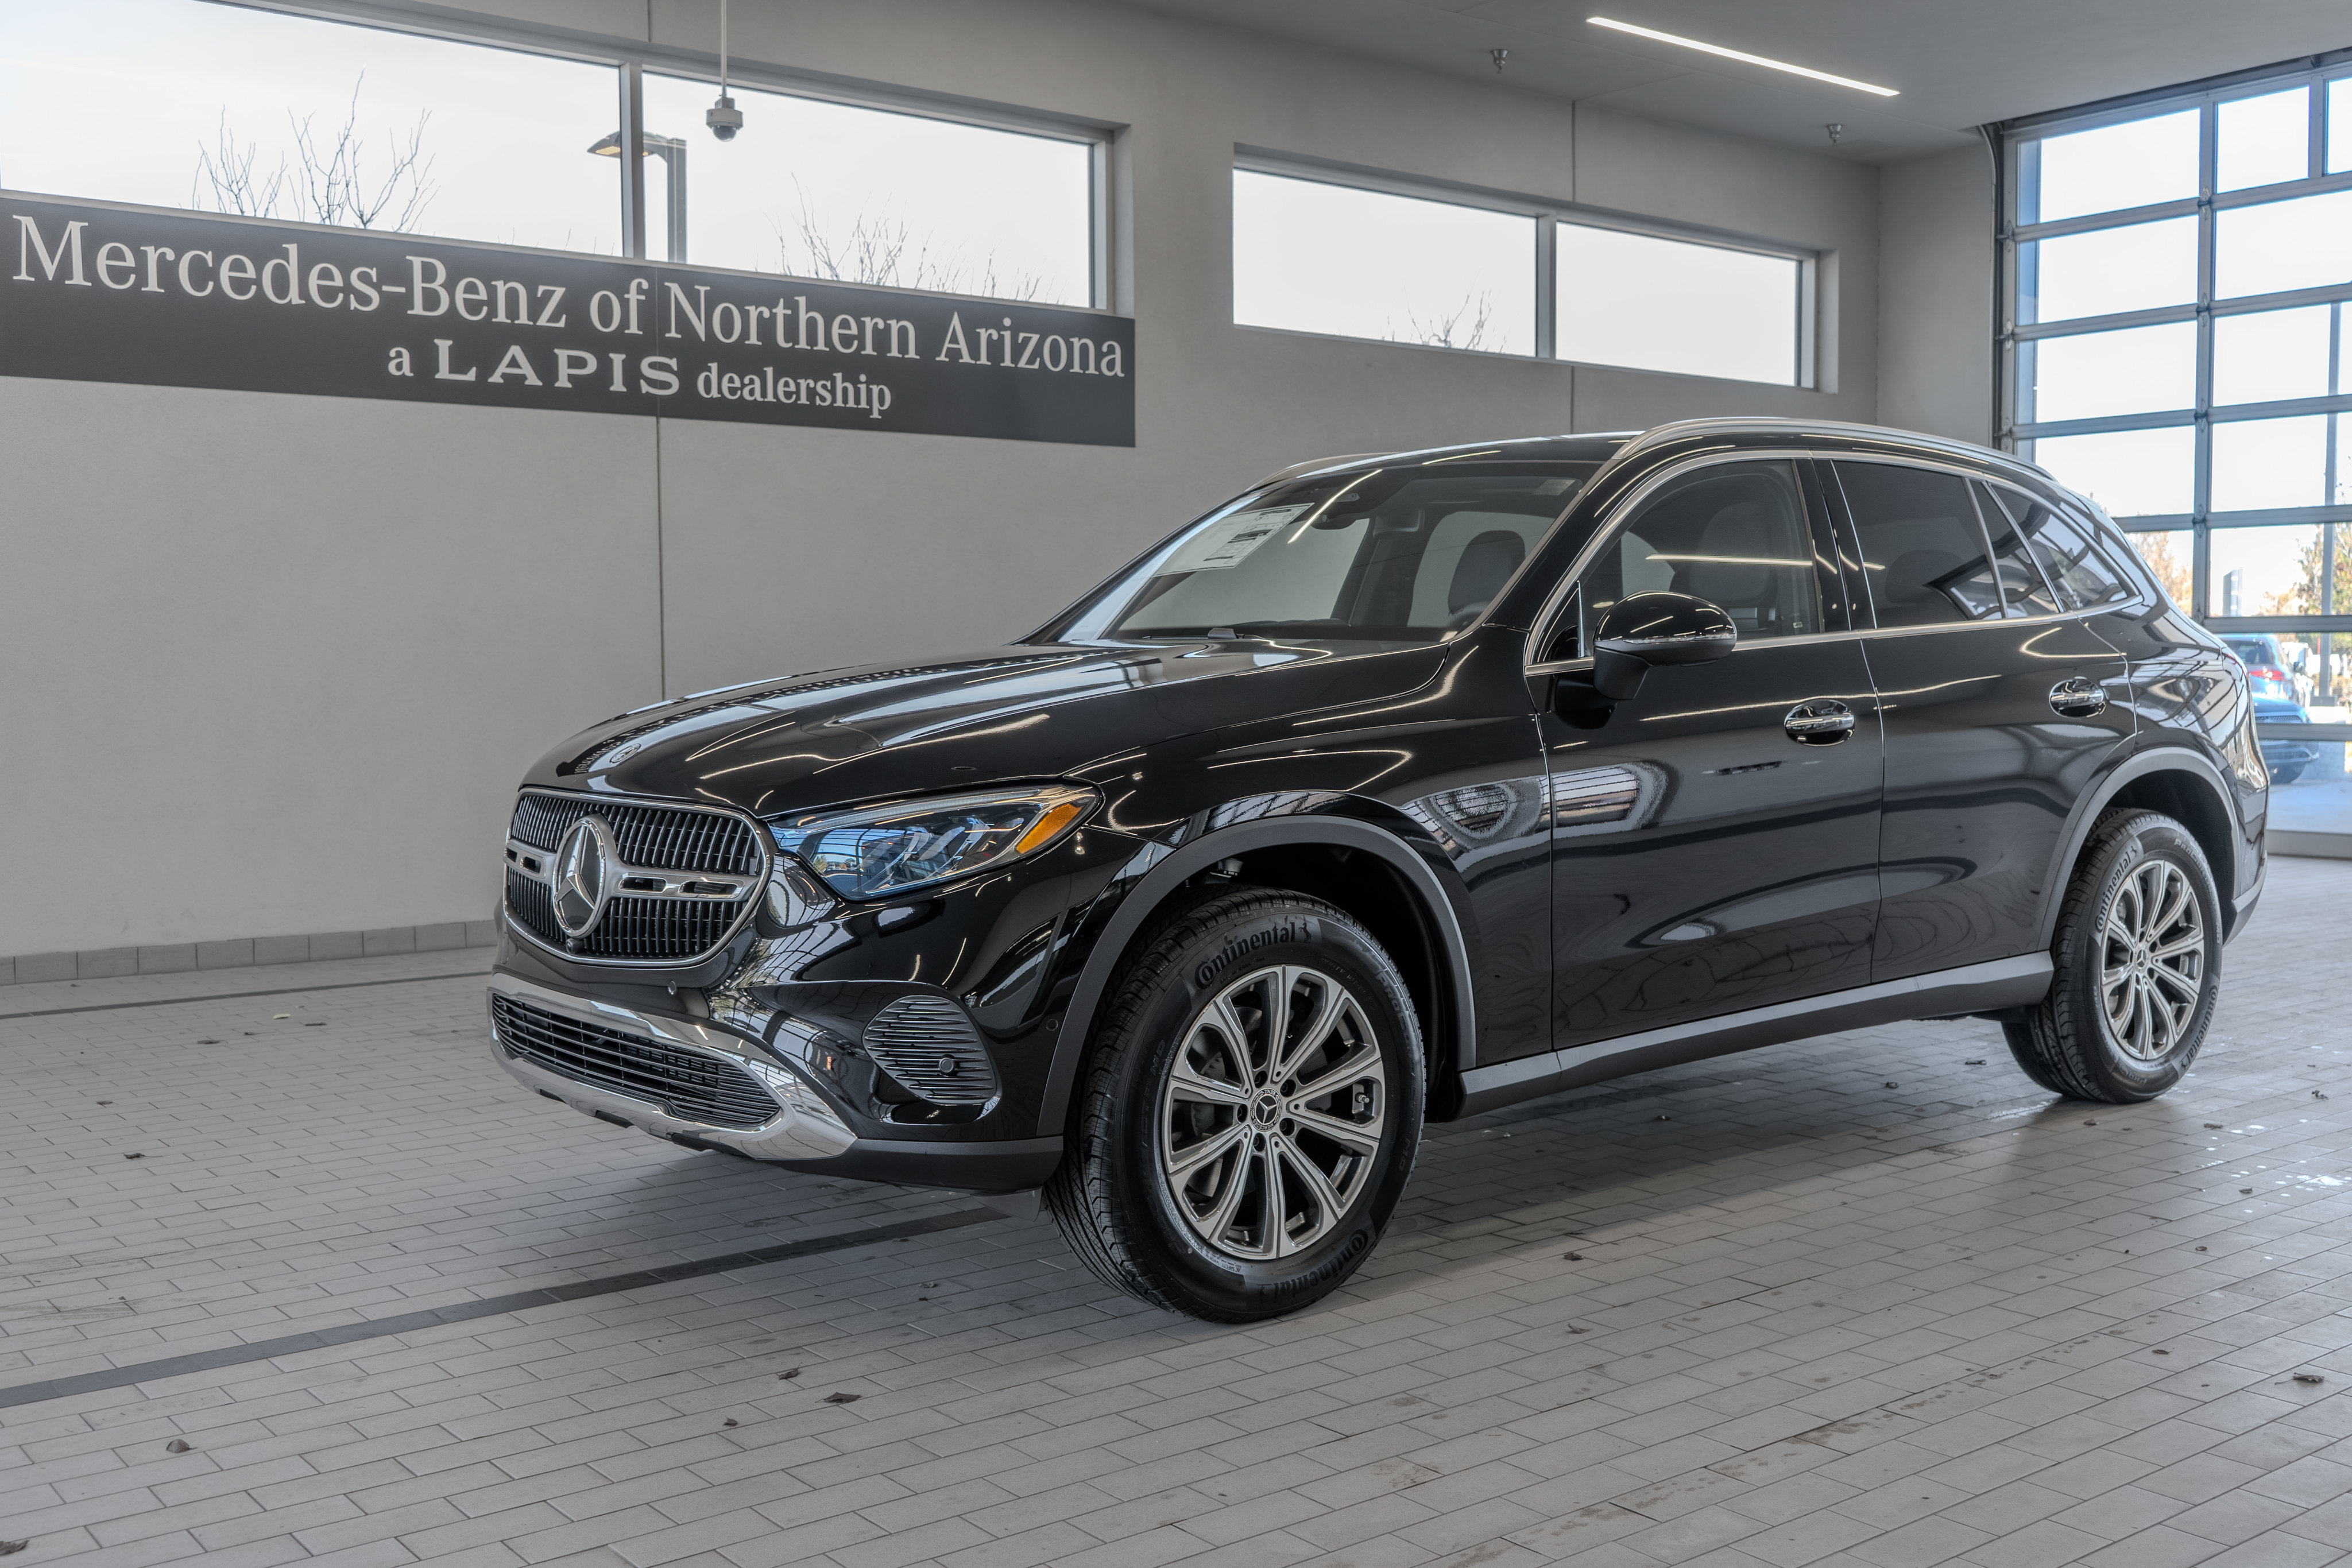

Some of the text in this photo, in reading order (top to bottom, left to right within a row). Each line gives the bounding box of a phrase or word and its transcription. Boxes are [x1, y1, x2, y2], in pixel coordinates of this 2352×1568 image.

[13, 215, 1125, 377] Mercedes-Benz of Northern Arizona
[388, 339, 892, 419] a LAPIS dealership
[2095, 850, 2132, 934] Continental
[1194, 922, 1295, 989] Continental
[2184, 981, 2218, 1063] Continental
[1252, 1118, 1274, 1130] MERCEDES
[1222, 1263, 1235, 1272] SAFETY
[1274, 1229, 1368, 1303] Continental
